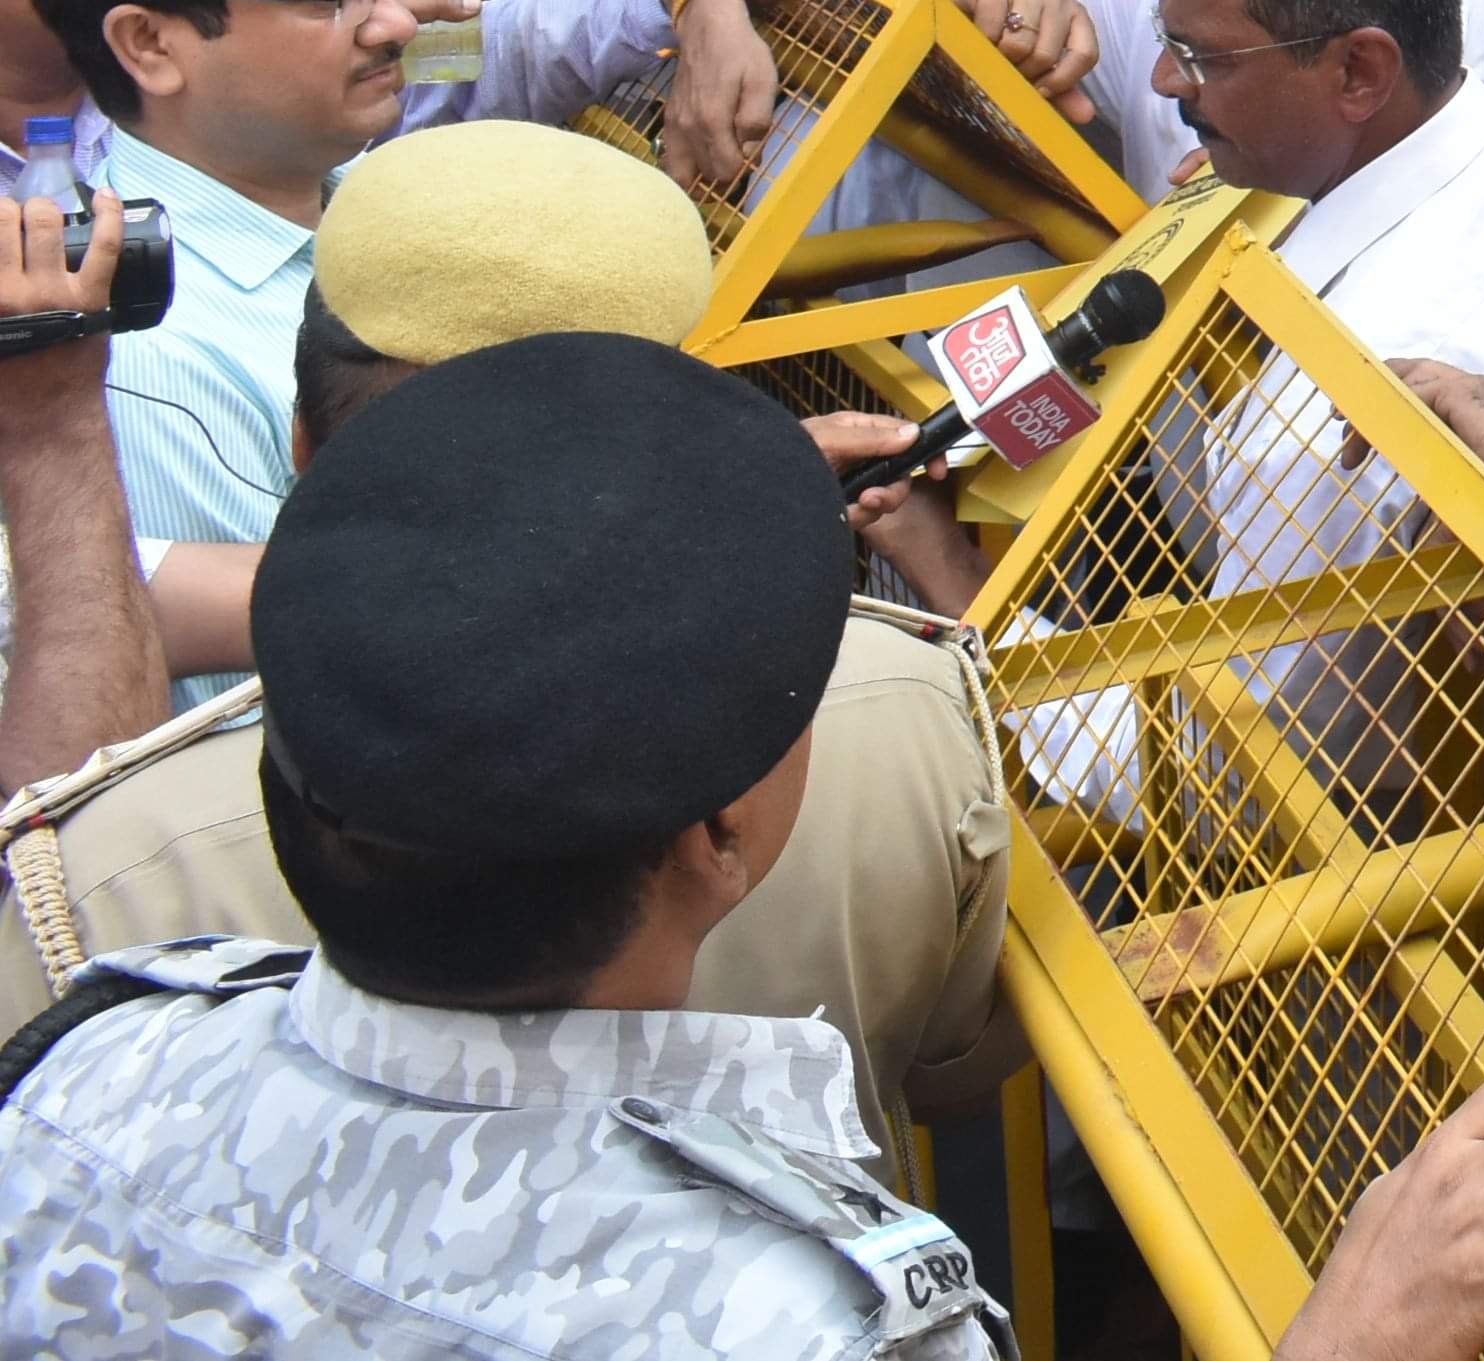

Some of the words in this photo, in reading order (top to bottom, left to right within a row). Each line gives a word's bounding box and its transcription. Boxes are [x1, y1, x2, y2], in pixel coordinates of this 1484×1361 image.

[1003, 399, 1062, 451] TODAY
[1028, 393, 1072, 433] INDIA
[903, 1251, 969, 1310] CRP
